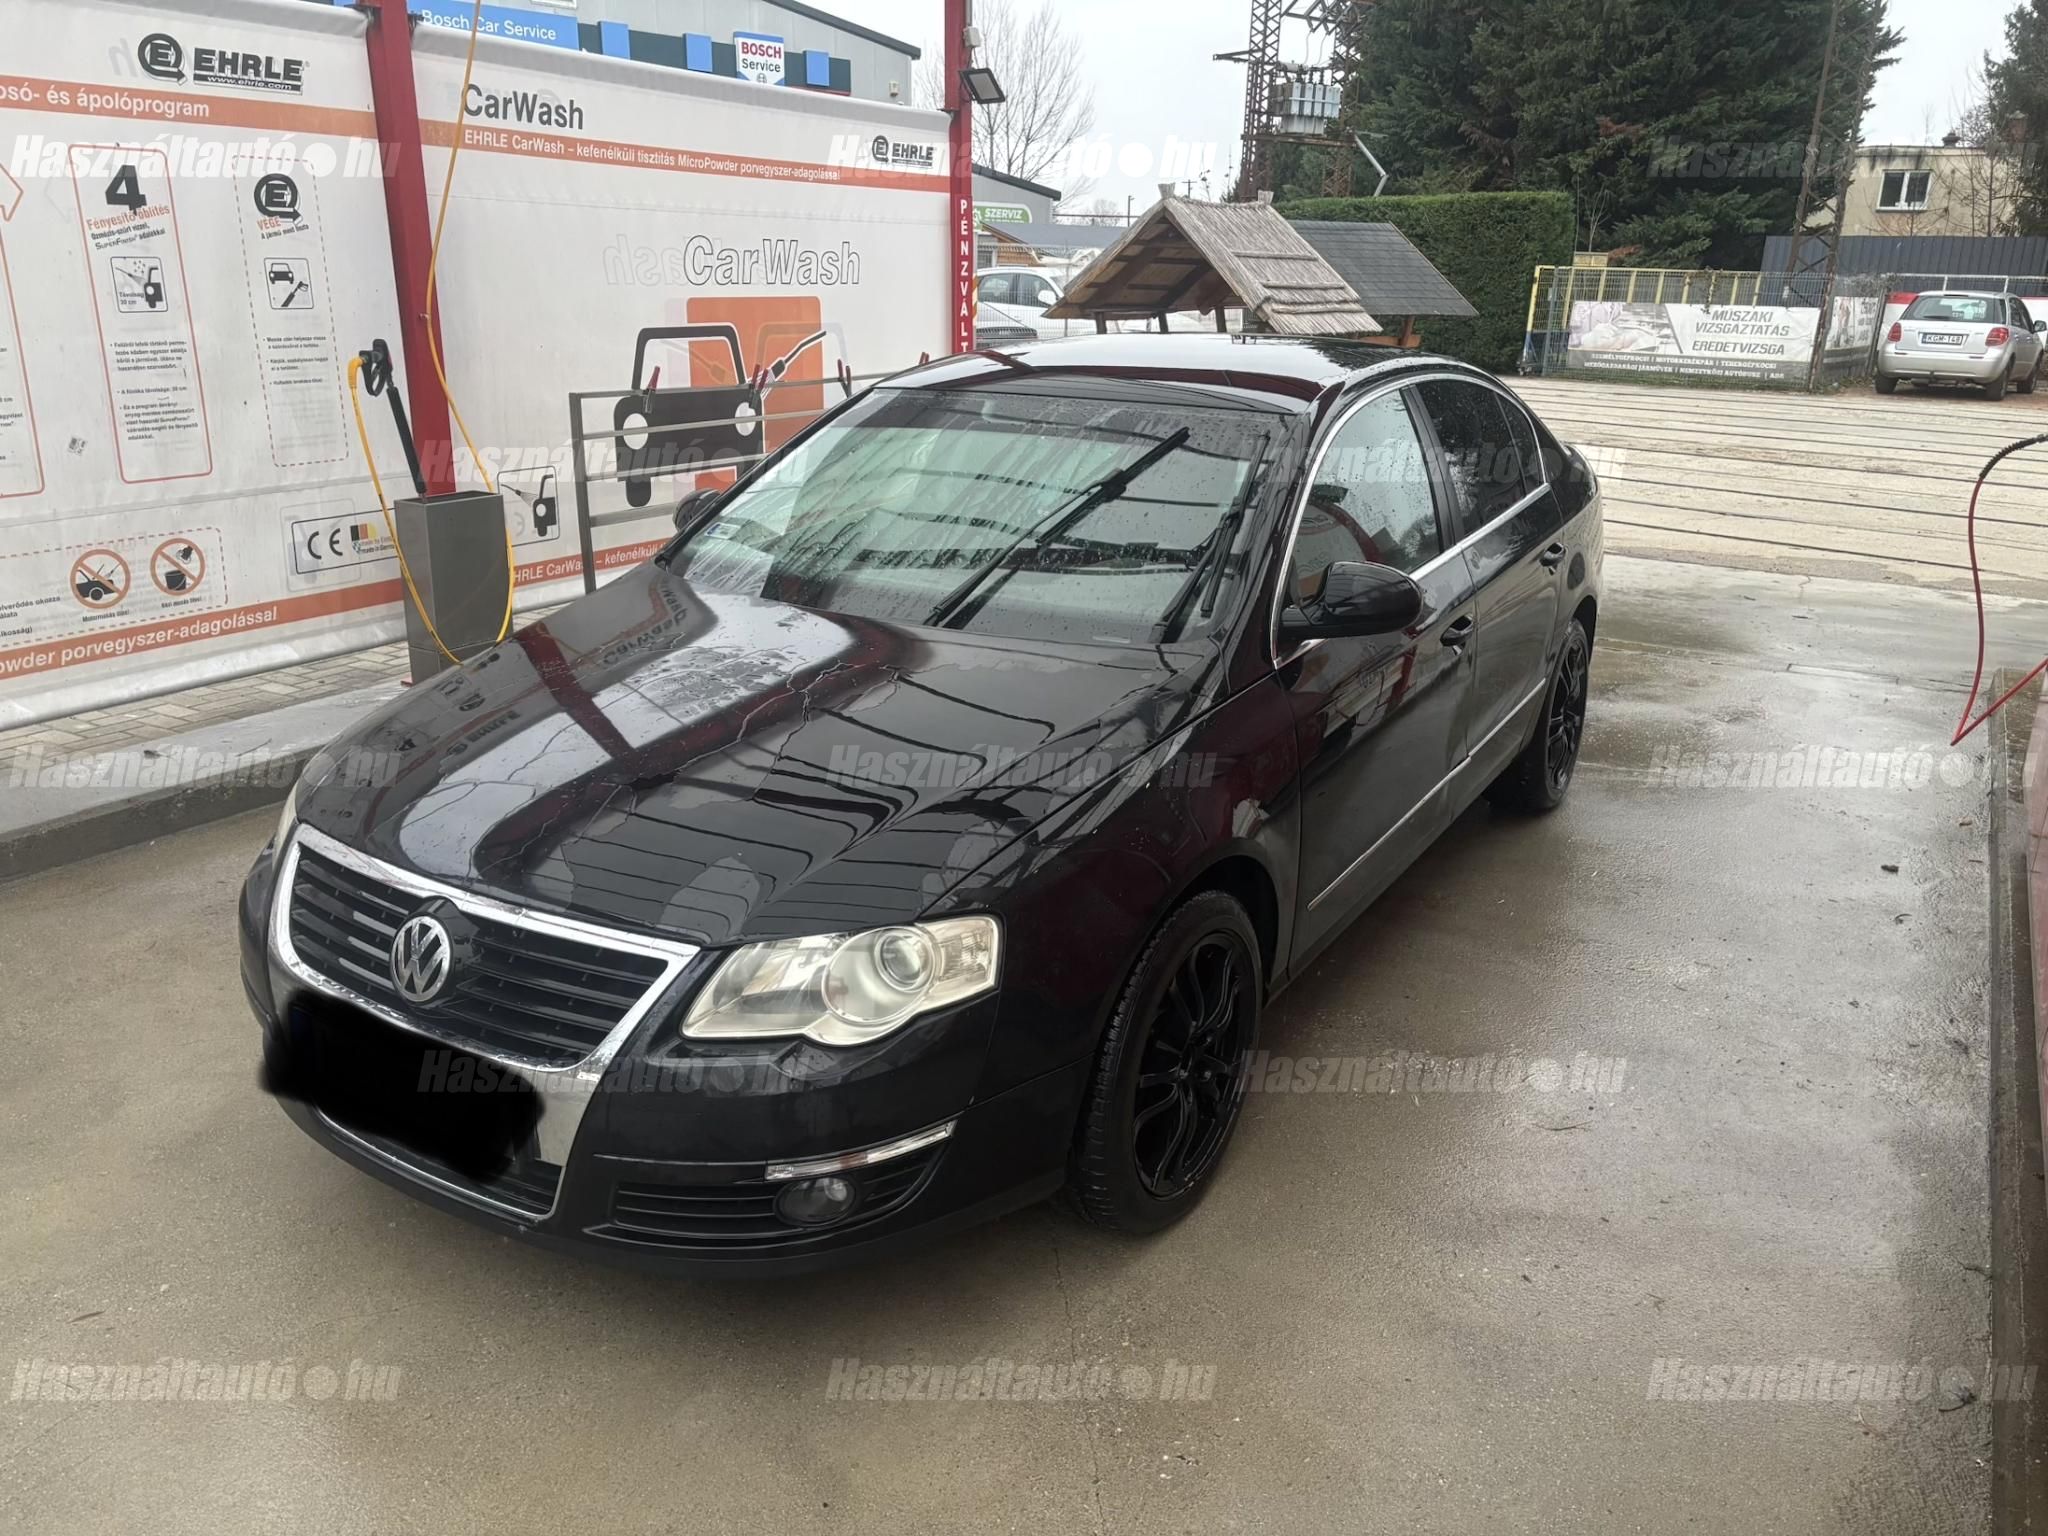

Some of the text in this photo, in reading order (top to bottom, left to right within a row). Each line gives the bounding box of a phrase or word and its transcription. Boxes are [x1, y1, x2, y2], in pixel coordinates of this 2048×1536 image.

[422, 10, 557, 40] Bosch Car Service
[194, 47, 303, 81] EHRLE
[741, 41, 782, 59] BOSCH
[742, 58, 781, 73] Service
[47, 86, 71, 105] és
[77, 86, 209, 118] ápolóprogram
[462, 83, 584, 130] CarWash
[464, 129, 508, 148] EHRLE
[512, 134, 565, 155] CarWash
[576, 143, 635, 161] kefenélküli
[678, 153, 738, 172] MicroPowder
[892, 143, 934, 160] EHRLE
[105, 164, 147, 211] 4
[984, 208, 1023, 219] SZERVIZ
[683, 234, 861, 285] CarWash
[1692, 340, 1785, 355] EREDETVIZSGA
[513, 565, 544, 583] HRLE
[546, 559, 583, 576] CarWa
[61, 606, 278, 666] porvegyszer-adagolással
